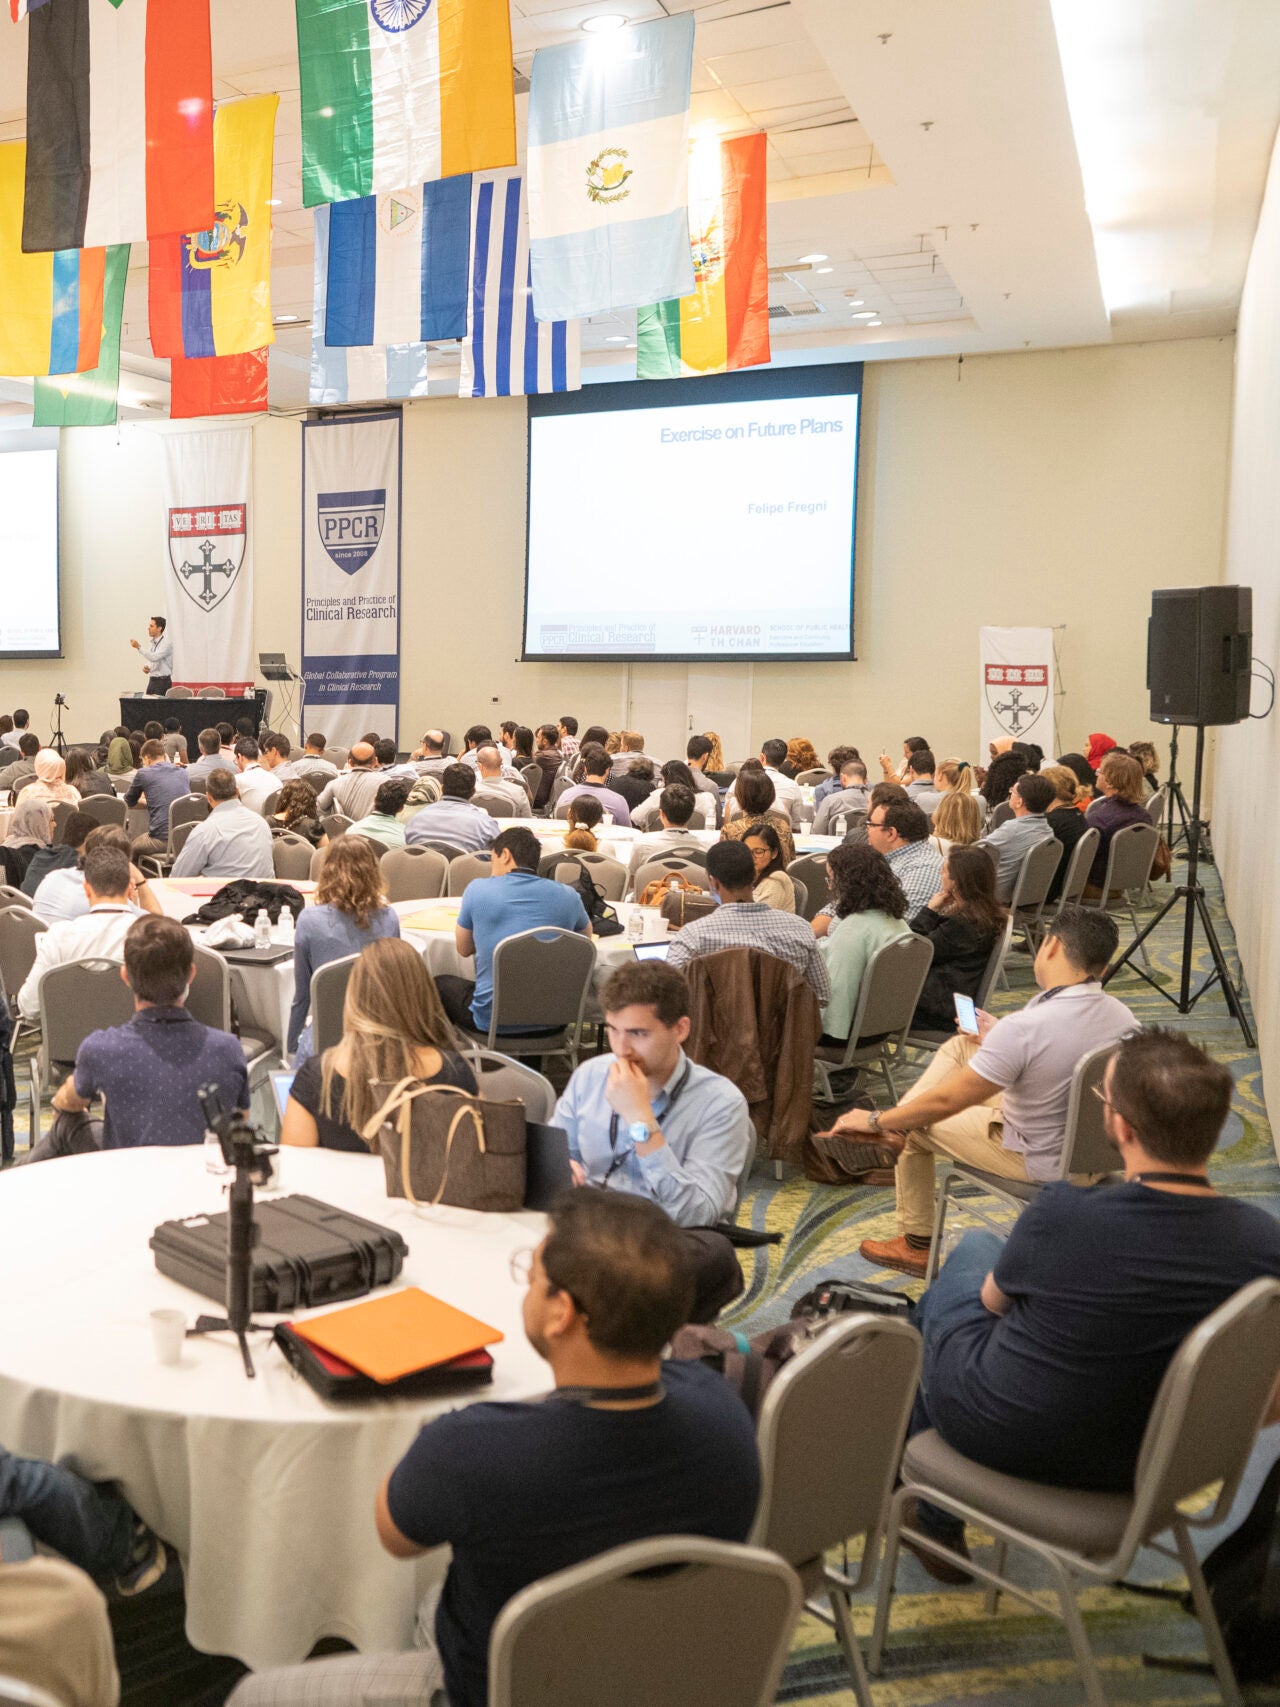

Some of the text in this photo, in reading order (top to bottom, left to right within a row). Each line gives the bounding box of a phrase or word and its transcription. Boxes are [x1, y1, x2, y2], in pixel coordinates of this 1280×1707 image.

[660, 418, 844, 443] Exercise on Future Plans
[748, 500, 828, 516] Felipe Fregni
[325, 516, 378, 540] PPCR
[307, 595, 396, 607] Principles and Practice of
[307, 605, 396, 620] Clinical Research
[710, 626, 762, 635] HARVARD
[608, 632, 656, 642] Research
[710, 638, 724, 647] TH
[729, 638, 761, 647] CHAN
[304, 670, 398, 680] Global Collaborative Program
[319, 682, 382, 692] in Clinical Research
